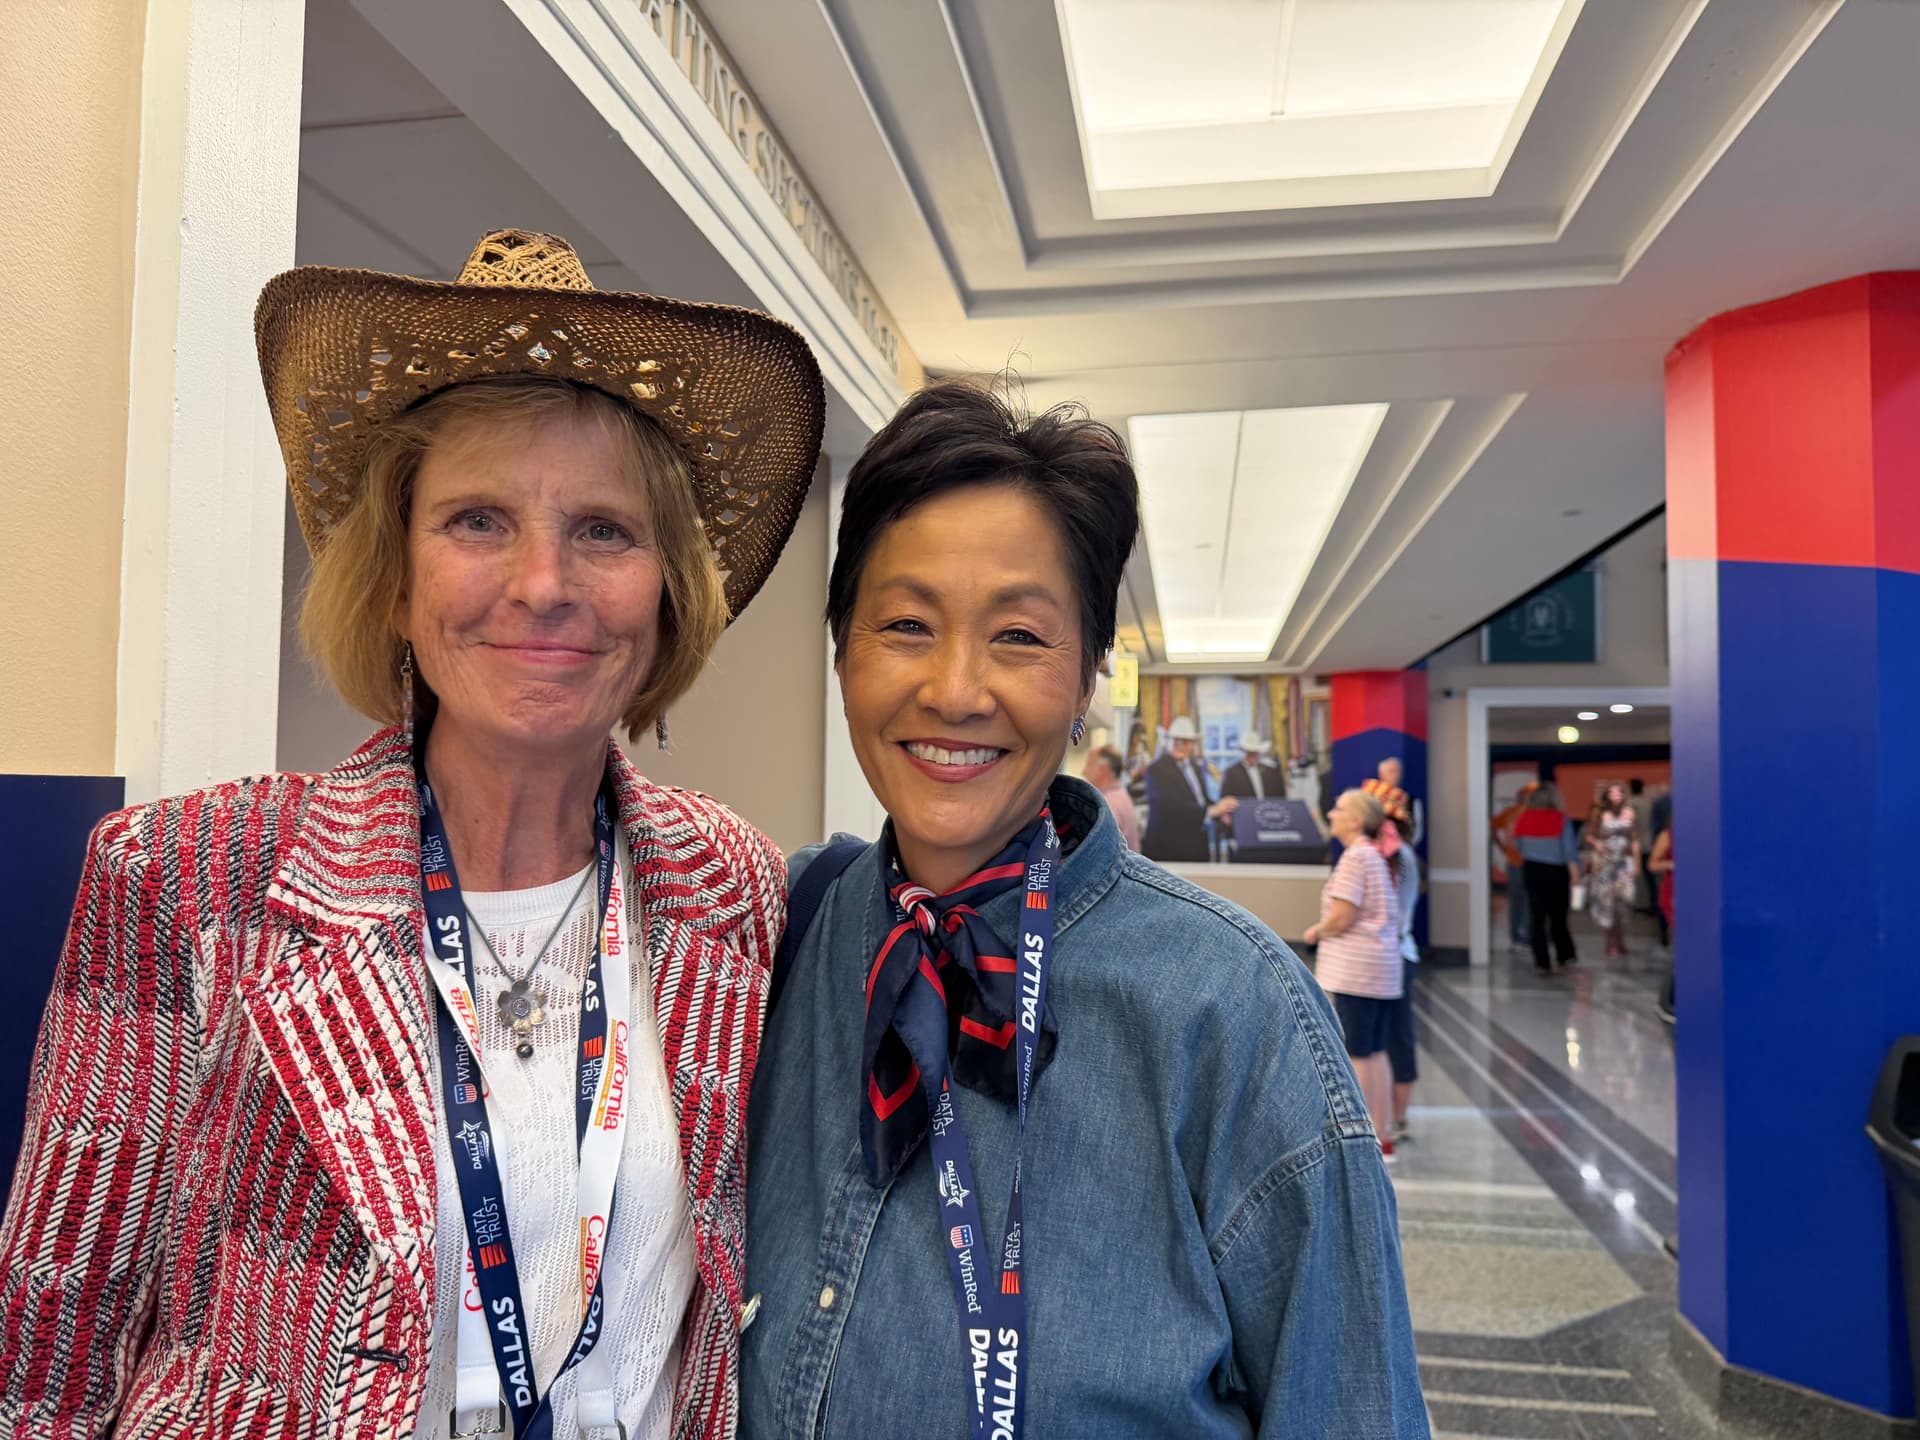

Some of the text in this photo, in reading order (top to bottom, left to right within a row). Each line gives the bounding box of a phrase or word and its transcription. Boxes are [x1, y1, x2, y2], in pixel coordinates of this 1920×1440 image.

[422, 842, 436, 874] DATA
[432, 834, 448, 871] TRUST
[1038, 857, 1052, 890] TRUST
[1027, 863, 1041, 890] DATA
[437, 915, 465, 975] LAS
[1022, 931, 1044, 1034] DALLAS
[581, 1060, 594, 1101] TRUST
[603, 1020, 628, 1131] California
[1022, 1045, 1032, 1101] WinRed
[939, 1092, 955, 1126] DATA
[467, 1131, 483, 1170] DALLAS
[945, 1160, 960, 1197] DALLAS
[473, 1207, 490, 1246] DATA
[482, 1196, 503, 1243] TRUST
[1003, 1231, 1015, 1269] DATA
[1011, 1221, 1021, 1267] TRUST
[957, 1249, 981, 1313] WinRed
[492, 1296, 533, 1408] DALLAS
[568, 1296, 601, 1367] DALL
[991, 1327, 1019, 1440] DALLAS
